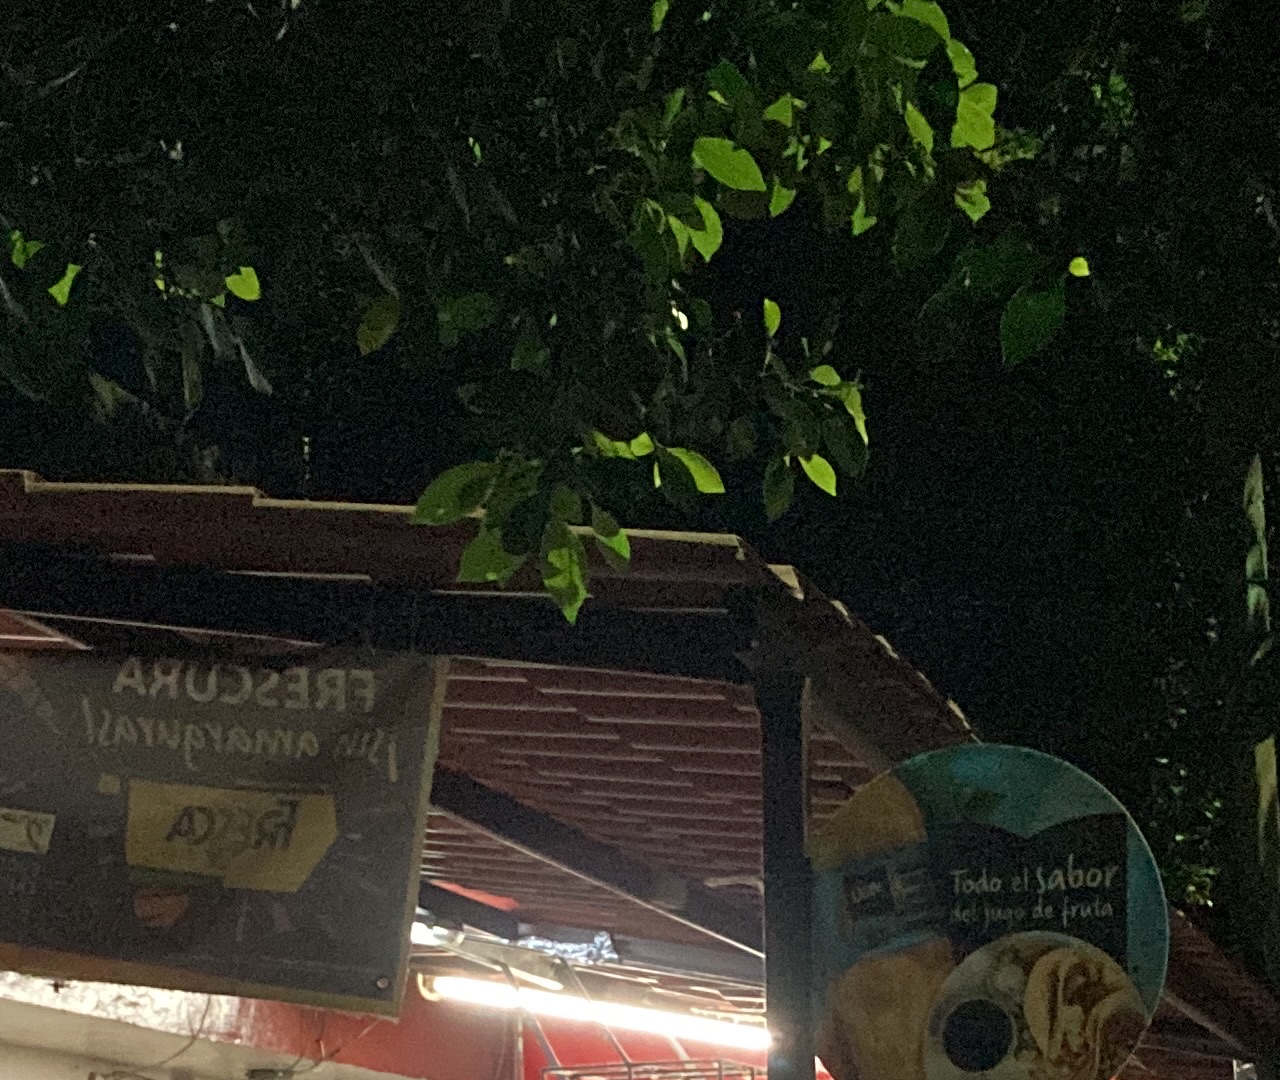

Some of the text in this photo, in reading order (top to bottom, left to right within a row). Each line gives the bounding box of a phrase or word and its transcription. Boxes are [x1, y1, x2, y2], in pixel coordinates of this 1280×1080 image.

[950, 867, 1003, 896] Todo
[1012, 866, 1029, 892] el
[1032, 894, 1055, 920] de
[1061, 895, 1115, 929] fruta
